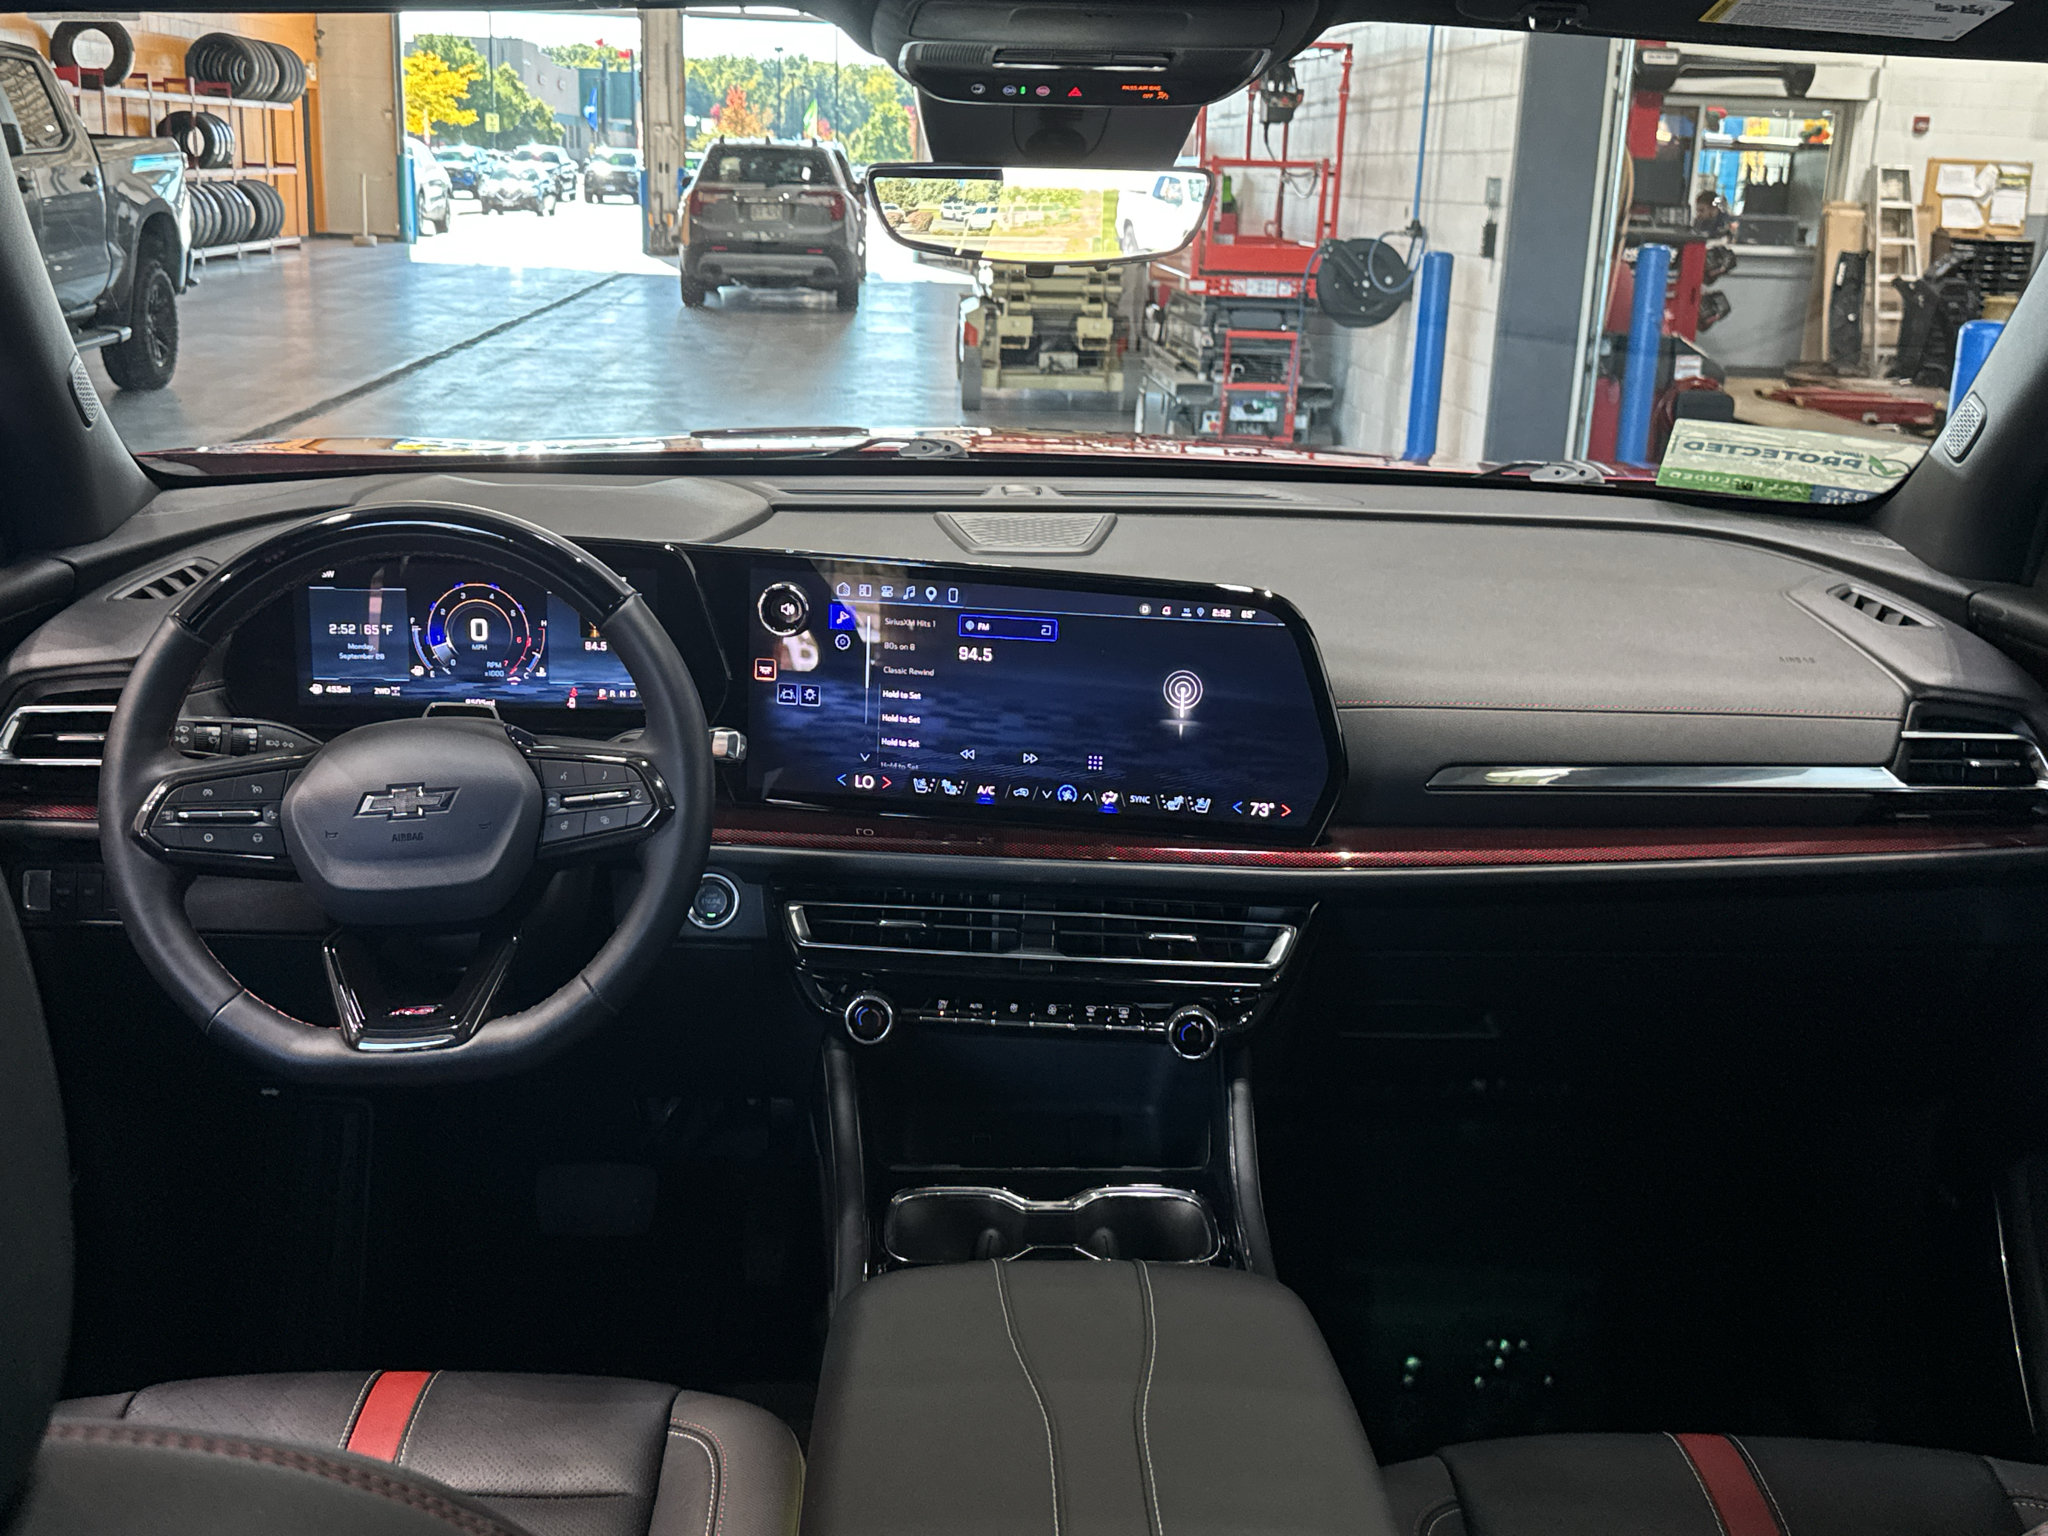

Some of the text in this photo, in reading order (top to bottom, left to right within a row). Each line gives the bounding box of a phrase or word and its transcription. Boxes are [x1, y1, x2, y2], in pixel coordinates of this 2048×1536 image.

[1211, 608, 1231, 618] 2:52
[328, 623, 356, 635] 2:52
[363, 623, 380, 635] 65
[470, 618, 488, 642] 0
[977, 622, 990, 631] FM
[471, 643, 488, 651] MPH
[338, 652, 374, 661] September
[958, 646, 993, 662] 94.5
[486, 661, 502, 669] RPM
[883, 666, 935, 677] Classic Rewind
[609, 689, 616, 698] R
[619, 689, 627, 698] N
[882, 689, 922, 700] Hold to Set
[881, 713, 921, 724] Hold to Set
[881, 737, 920, 748] Hold to Set
[854, 774, 875, 789] LO
[976, 784, 996, 796] A/C
[1129, 794, 1151, 804] SYNC
[1250, 802, 1275, 817] 73°
[392, 832, 424, 842] AIRBAG
